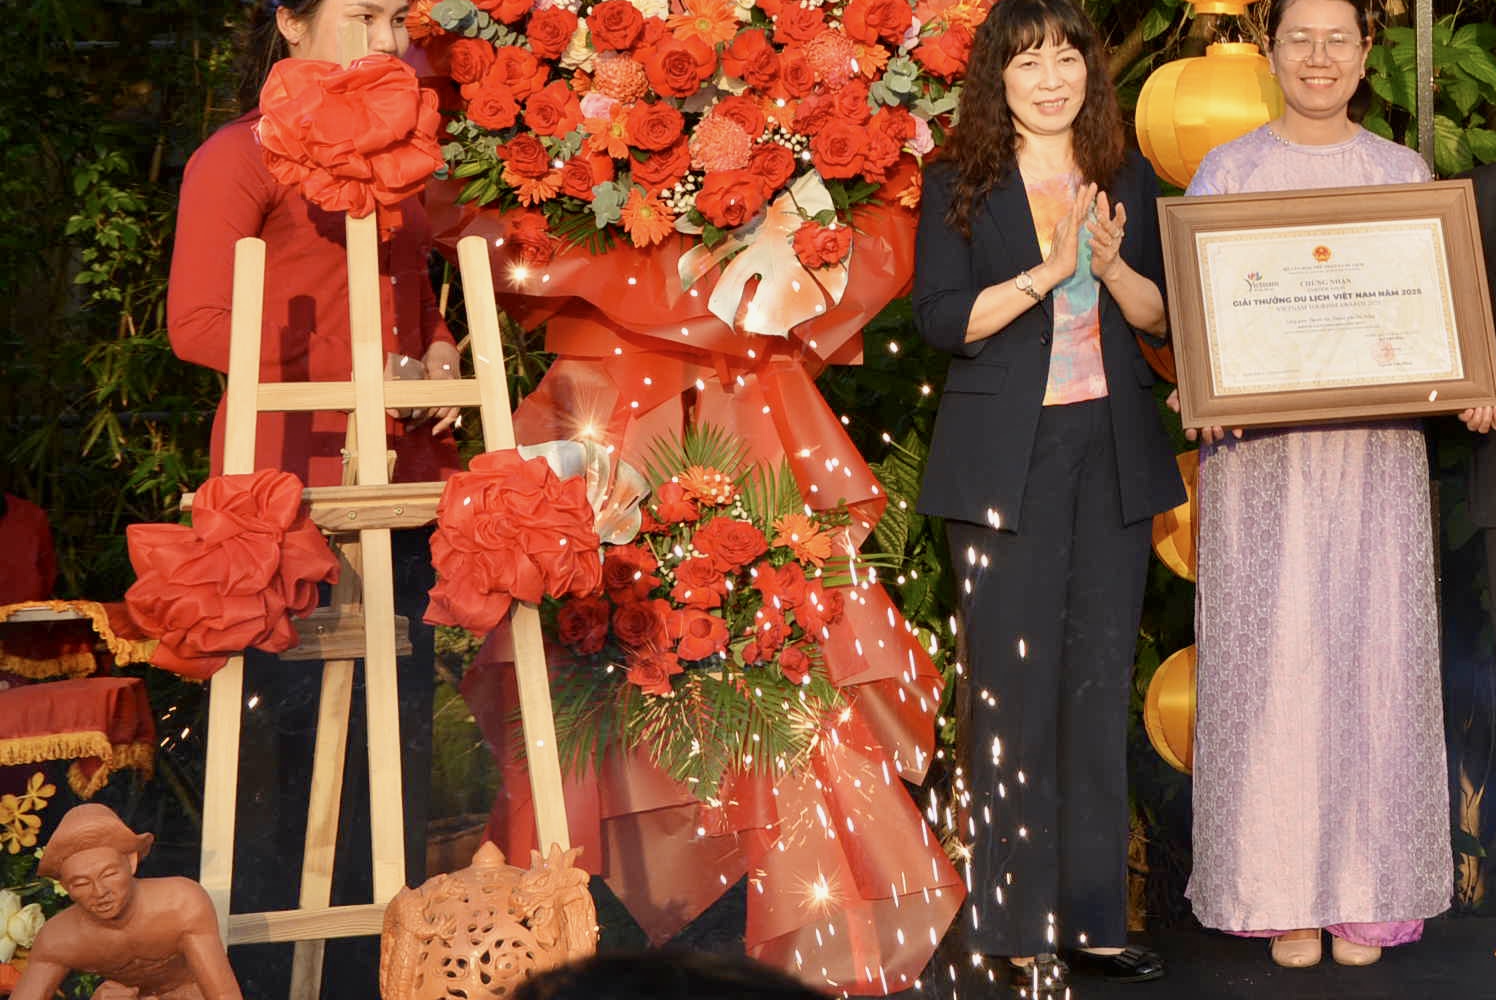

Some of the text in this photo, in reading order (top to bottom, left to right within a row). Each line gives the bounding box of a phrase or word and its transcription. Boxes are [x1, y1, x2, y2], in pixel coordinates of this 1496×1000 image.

[1294, 295, 1307, 303] DU
[1309, 293, 1330, 303] LỊCH
[1356, 290, 1377, 299] NAM
